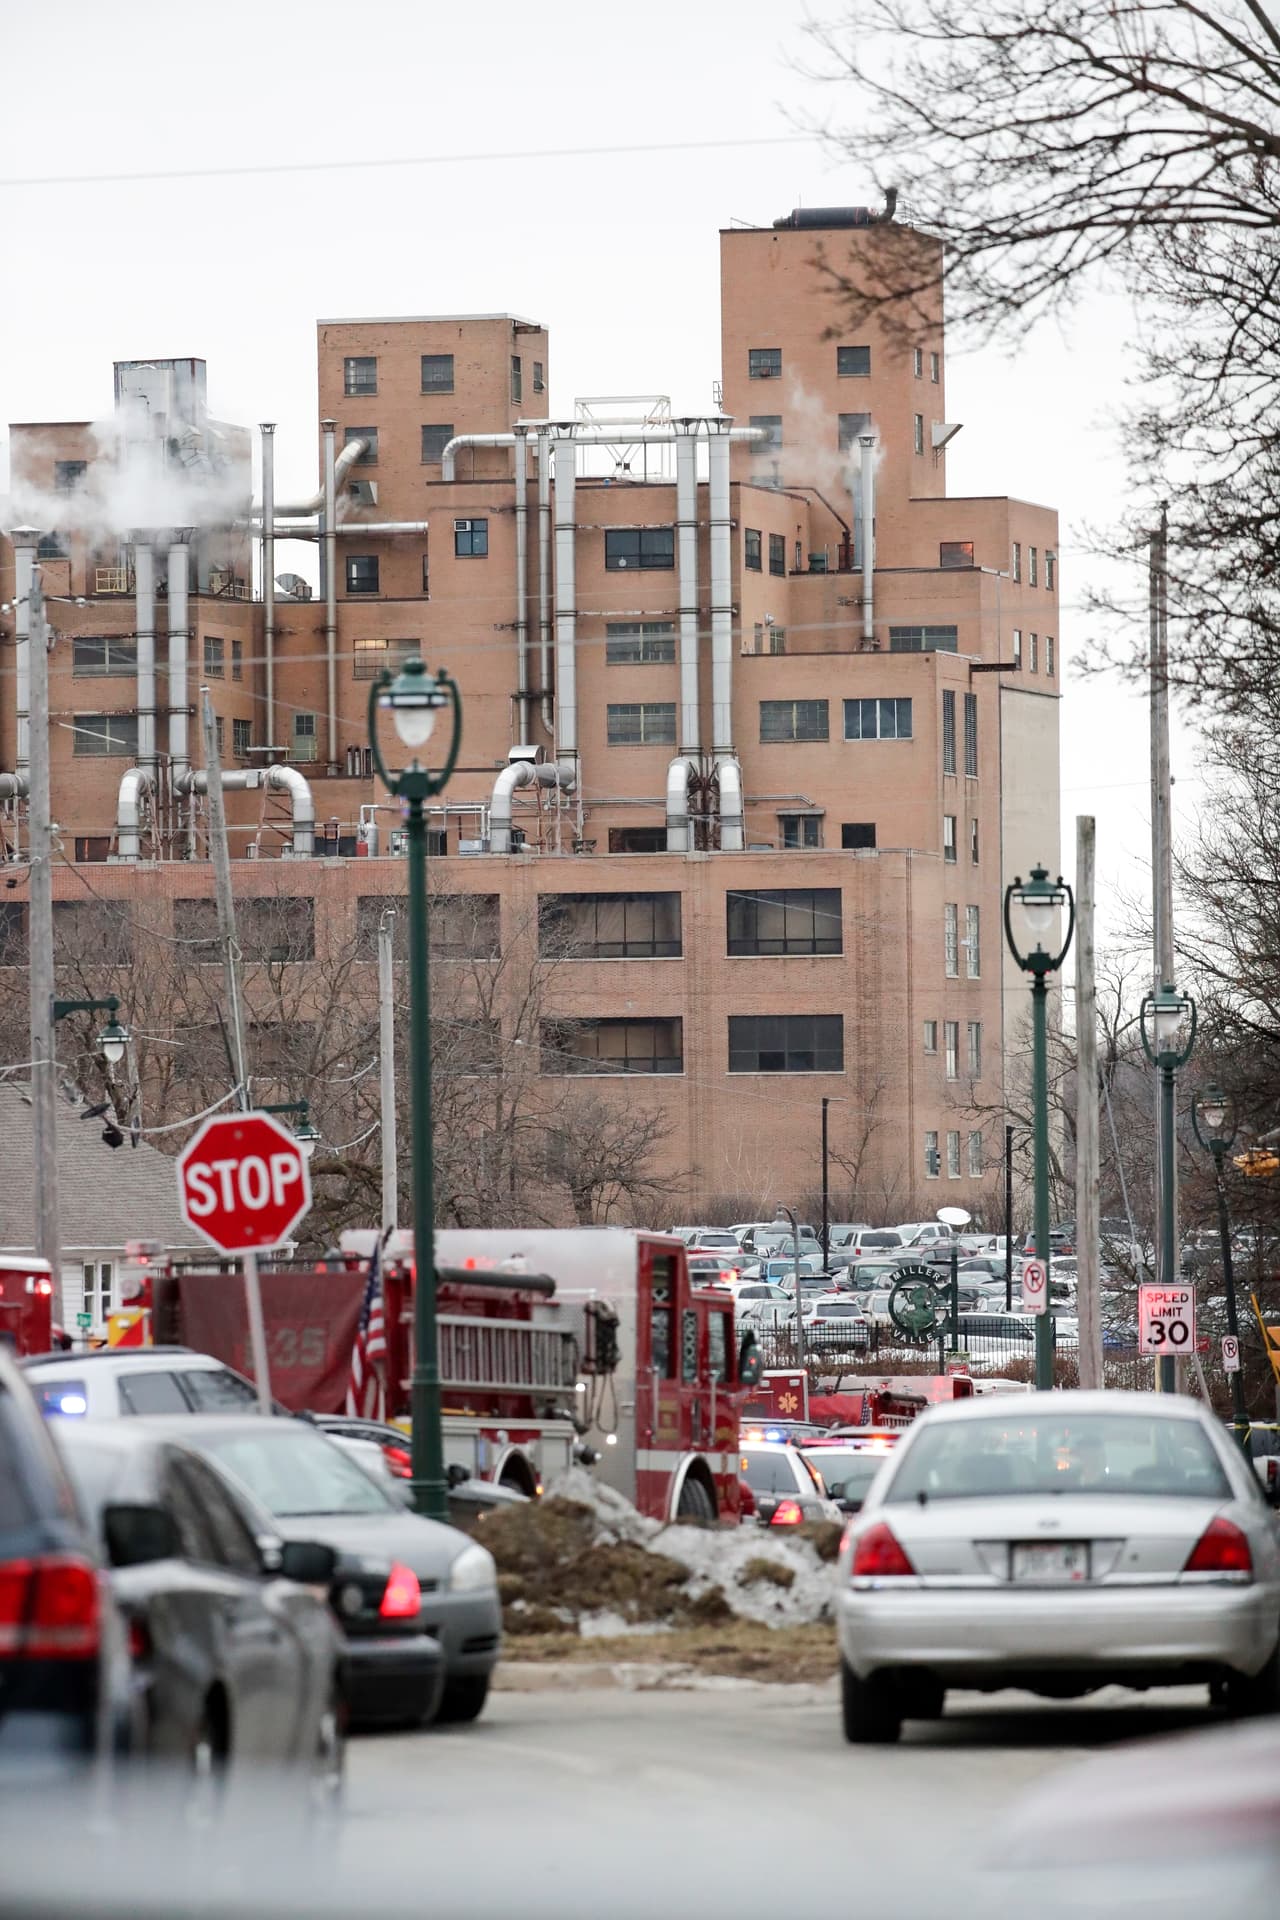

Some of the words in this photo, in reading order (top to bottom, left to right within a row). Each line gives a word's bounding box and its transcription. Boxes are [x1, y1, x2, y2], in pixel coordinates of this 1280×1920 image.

[186, 1152, 301, 1217] STOP
[892, 1266, 941, 1281] MILLER
[1151, 1307, 1183, 1317] LIMIT
[893, 1329, 938, 1344] VALLE
[1147, 1320, 1189, 1345] 30
